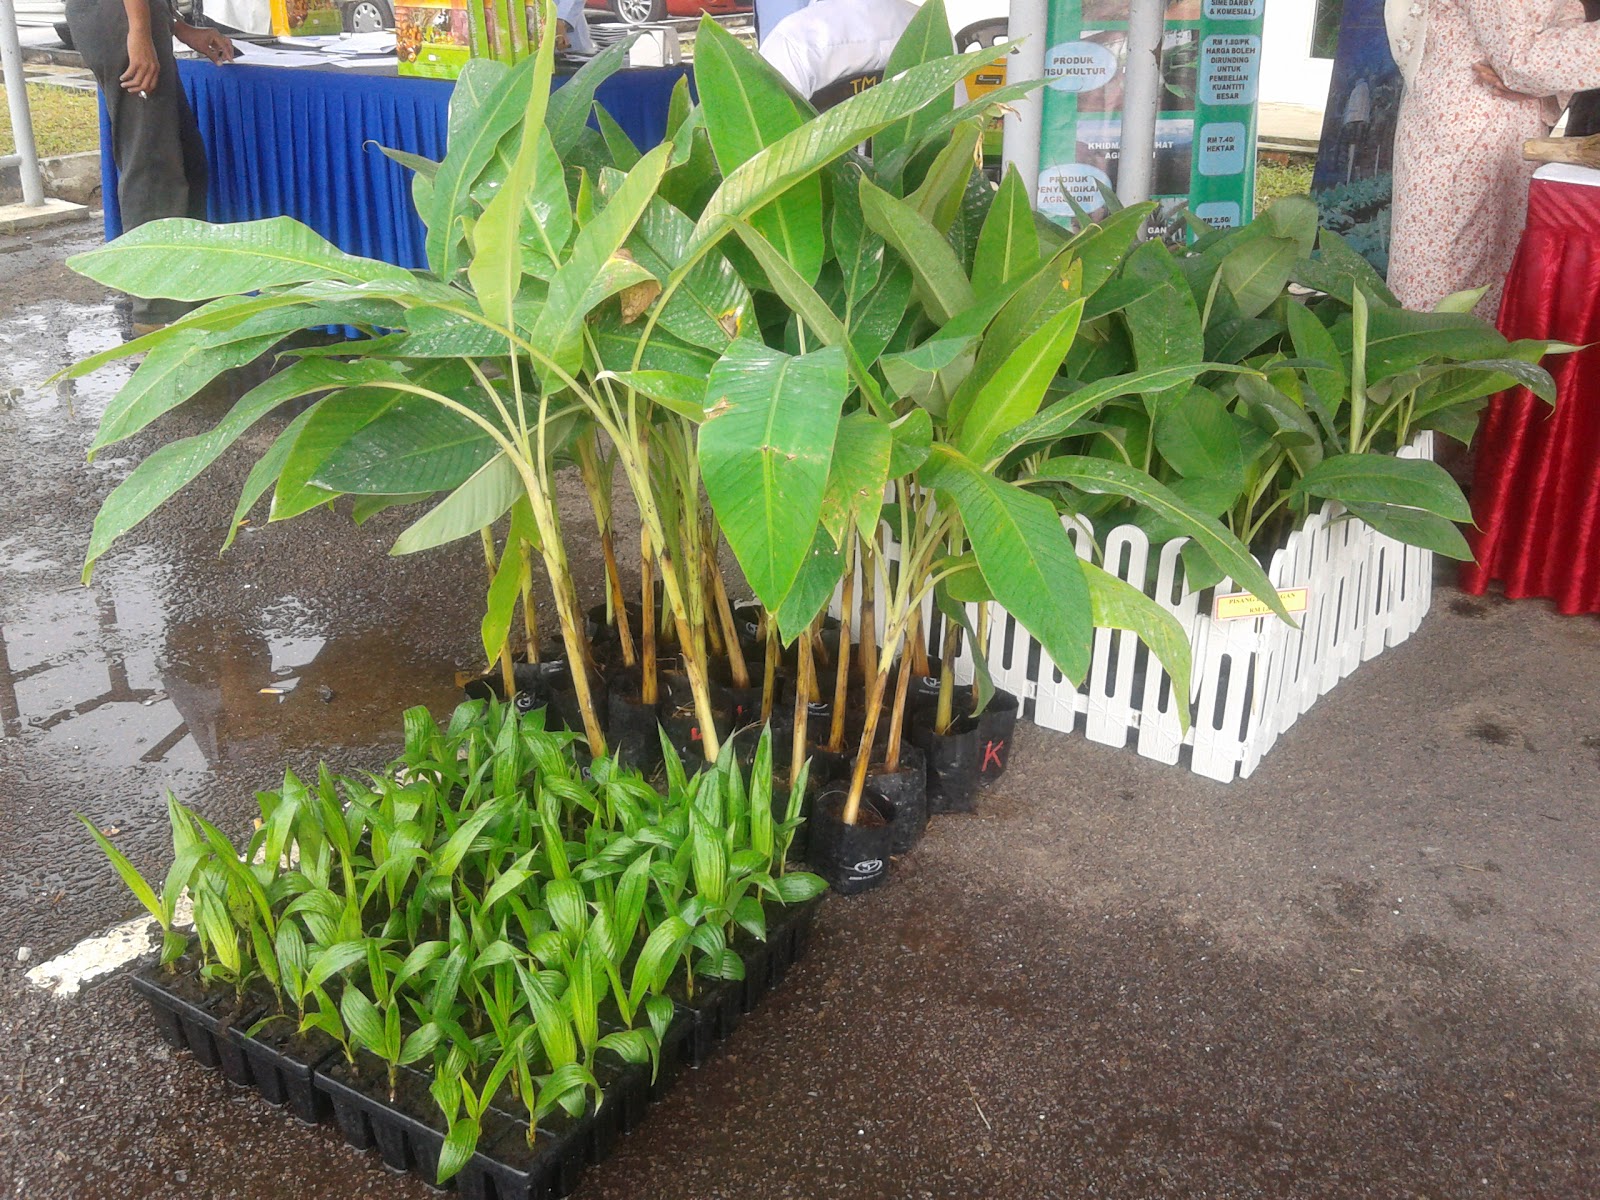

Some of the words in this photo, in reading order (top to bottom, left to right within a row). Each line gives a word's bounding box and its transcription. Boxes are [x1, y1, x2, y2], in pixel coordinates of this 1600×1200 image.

[1053, 57, 1094, 65] PRODUK
[1066, 67, 1106, 75] KULTUR
[1088, 142, 1120, 150] KHIDM
[1049, 175, 1089, 183] PRODUK
[1228, 597, 1255, 605] PISANG
[981, 740, 1004, 772] K
